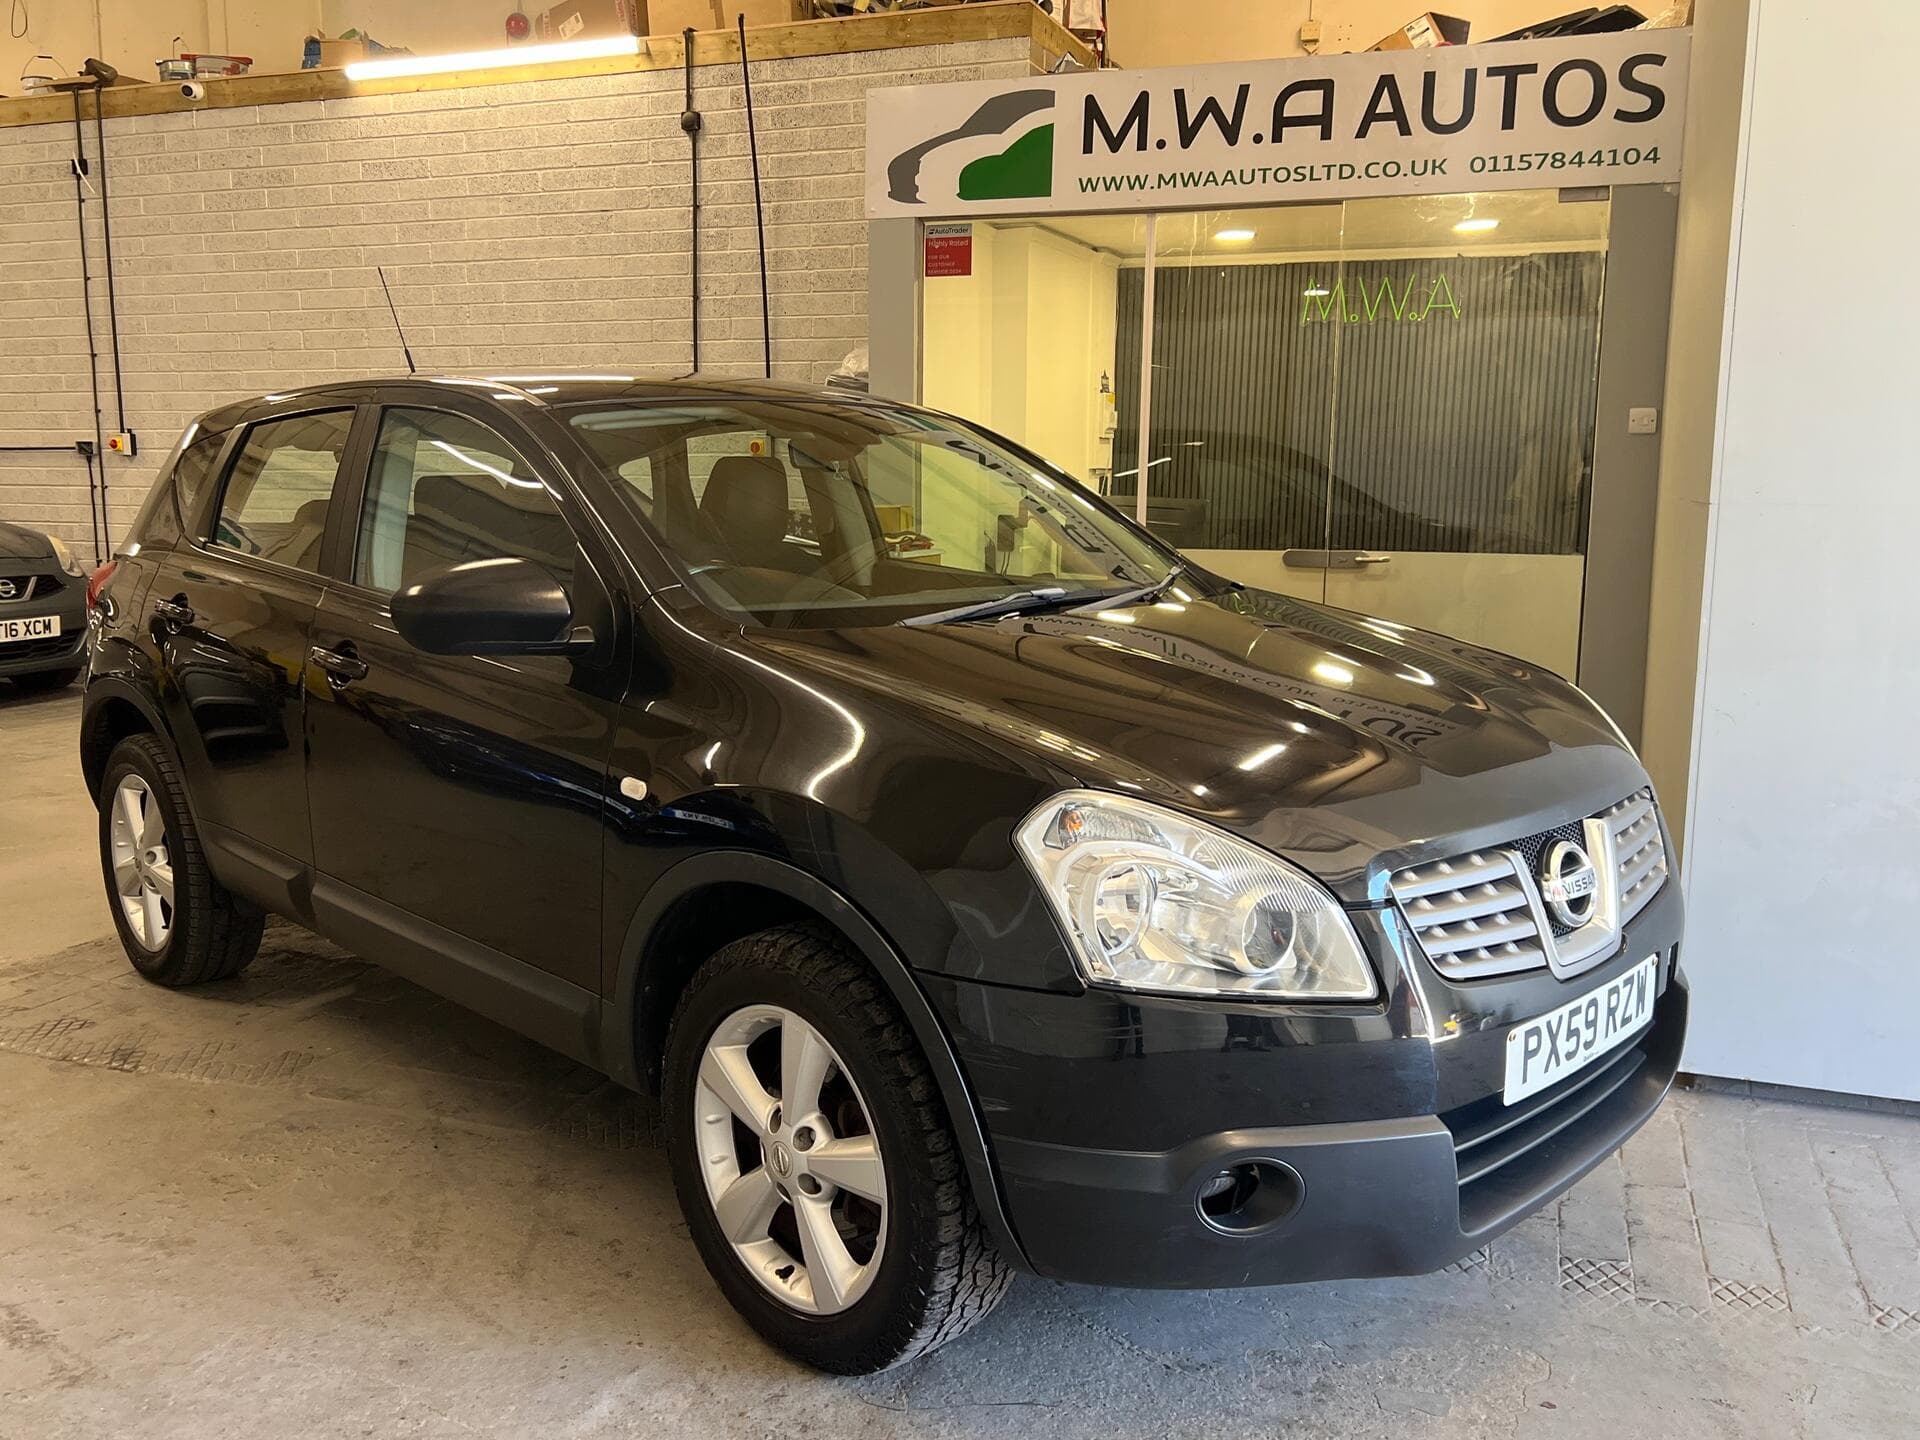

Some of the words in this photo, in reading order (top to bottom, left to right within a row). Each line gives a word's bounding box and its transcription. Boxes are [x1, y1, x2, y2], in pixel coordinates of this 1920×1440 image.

[1082, 78, 1335, 154] M.W.A
[1354, 53, 1667, 139] AUTOS
[1078, 158, 1448, 193] WWW.MWAAUTOSLTD.CO.UK
[1469, 147, 1661, 173] 01157844104
[928, 239, 948, 248] Highly
[949, 239, 969, 247] Rated
[1302, 273, 1461, 325] M.W.A
[23, 618, 52, 636] XCM
[1521, 996, 1599, 1085] PX59
[1604, 964, 1648, 1039] RZW
